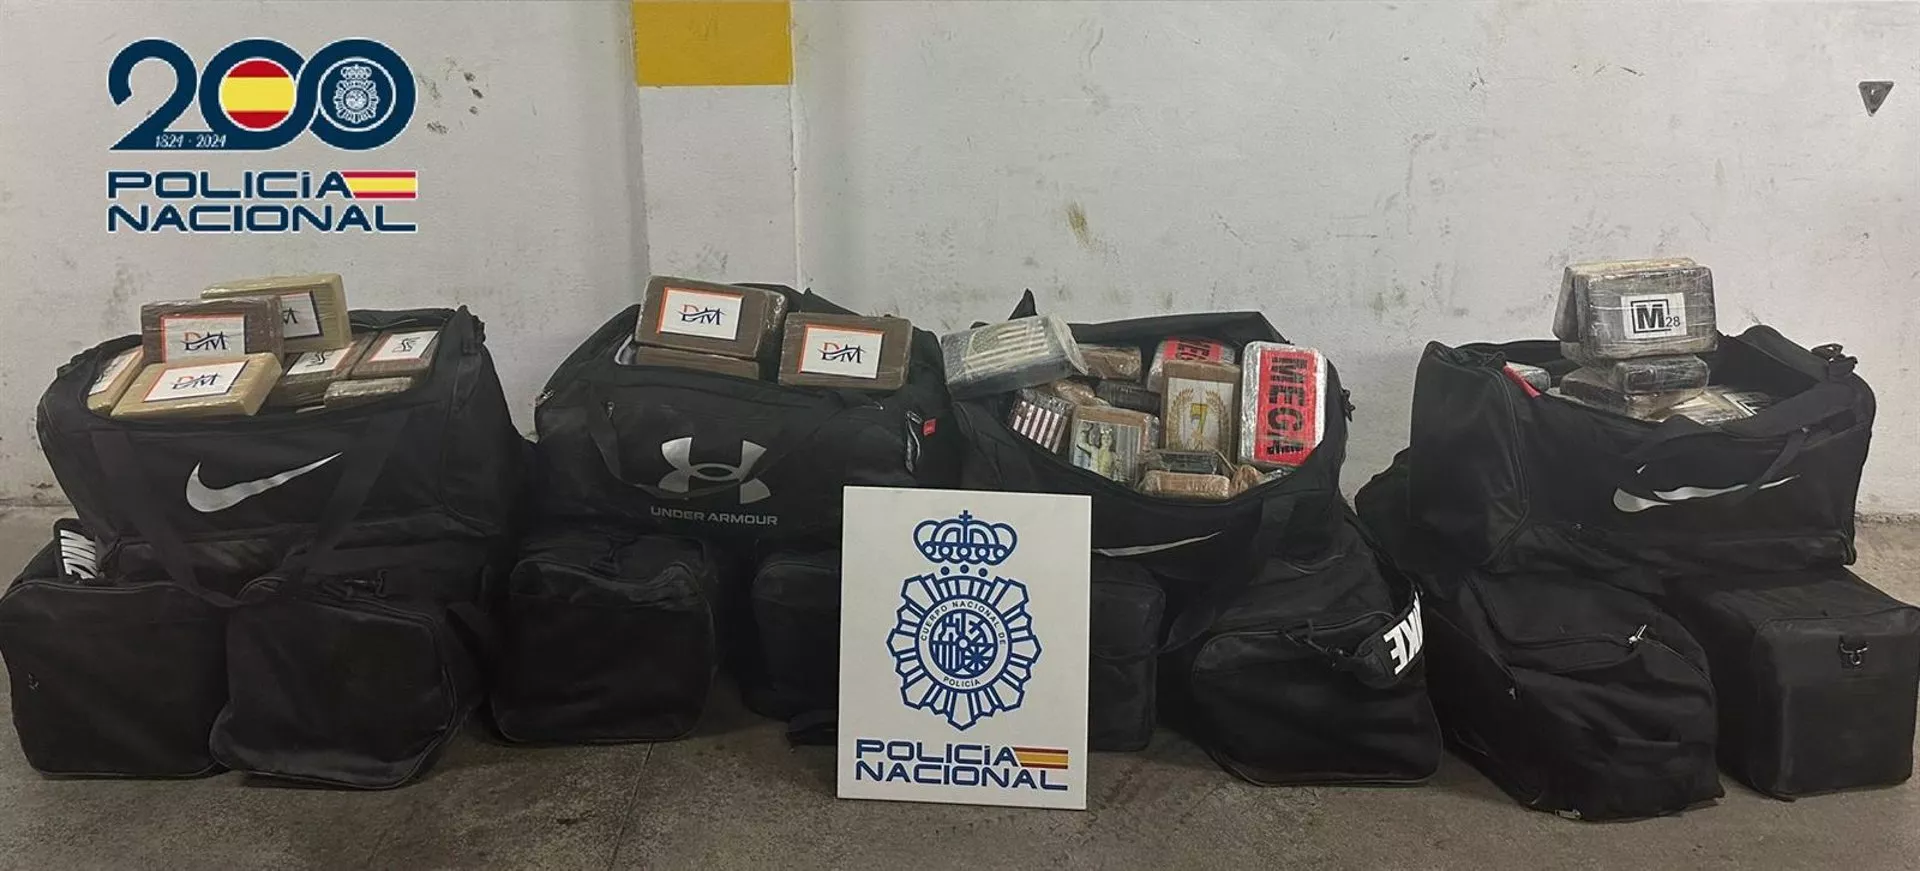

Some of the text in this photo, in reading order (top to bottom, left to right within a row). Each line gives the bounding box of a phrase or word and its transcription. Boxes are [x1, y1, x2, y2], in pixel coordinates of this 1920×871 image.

[677, 303, 726, 326] DM
[181, 331, 230, 352] DM
[818, 341, 867, 365] DM
[1266, 356, 1308, 456] MEGA
[650, 505, 779, 526] UNDER ARMOUR
[920, 600, 1007, 646] CUERPO NACIONAL DE
[855, 760, 1069, 791] NACIONAL
